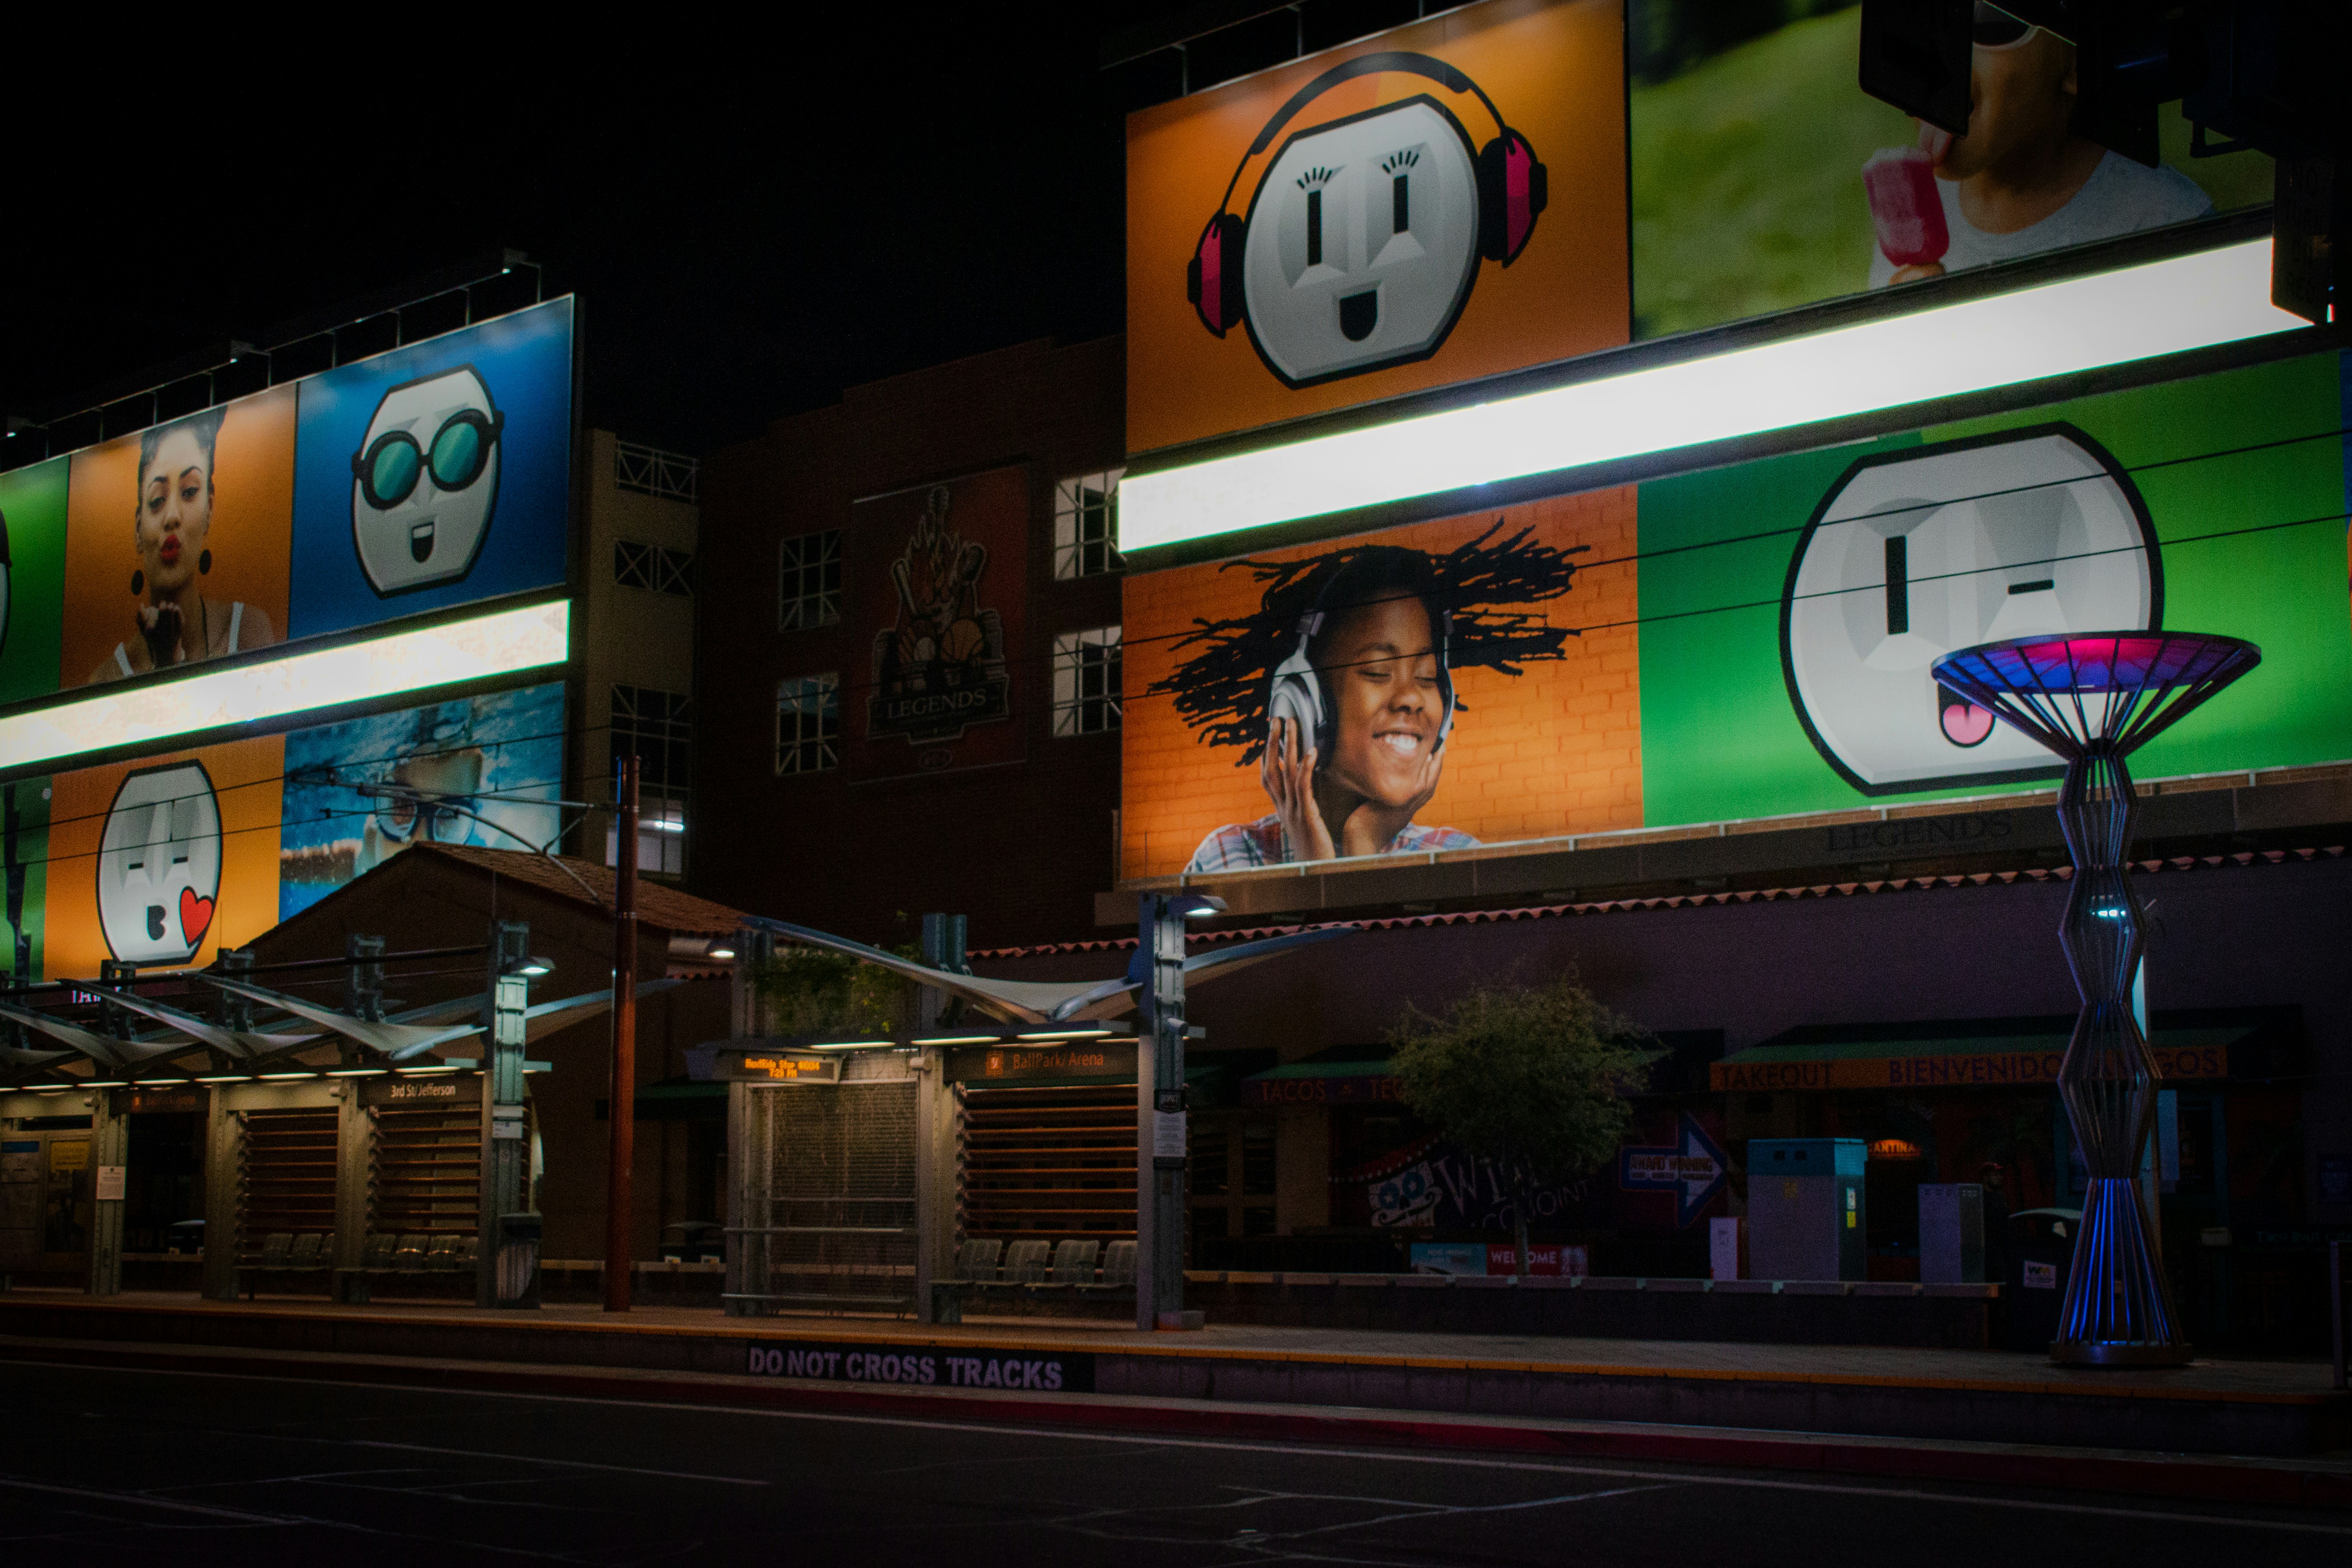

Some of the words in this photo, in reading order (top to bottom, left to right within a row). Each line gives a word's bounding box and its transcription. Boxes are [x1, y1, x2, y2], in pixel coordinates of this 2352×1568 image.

[886, 688, 987, 719] LEGENDS
[1828, 811, 2011, 851] LEGENDS
[1720, 1062, 1834, 1088] TAKEOUT
[1889, 1054, 2066, 1084] BIENVENIDO
[391, 1085, 405, 1098] 3rd
[1261, 1079, 1325, 1102] TACOS
[1491, 1250, 1557, 1265] WELOME
[748, 1347, 783, 1375] DO
[787, 1350, 841, 1377] NOT
[846, 1353, 936, 1384] CROSS
[946, 1357, 1062, 1390] TRACKS
